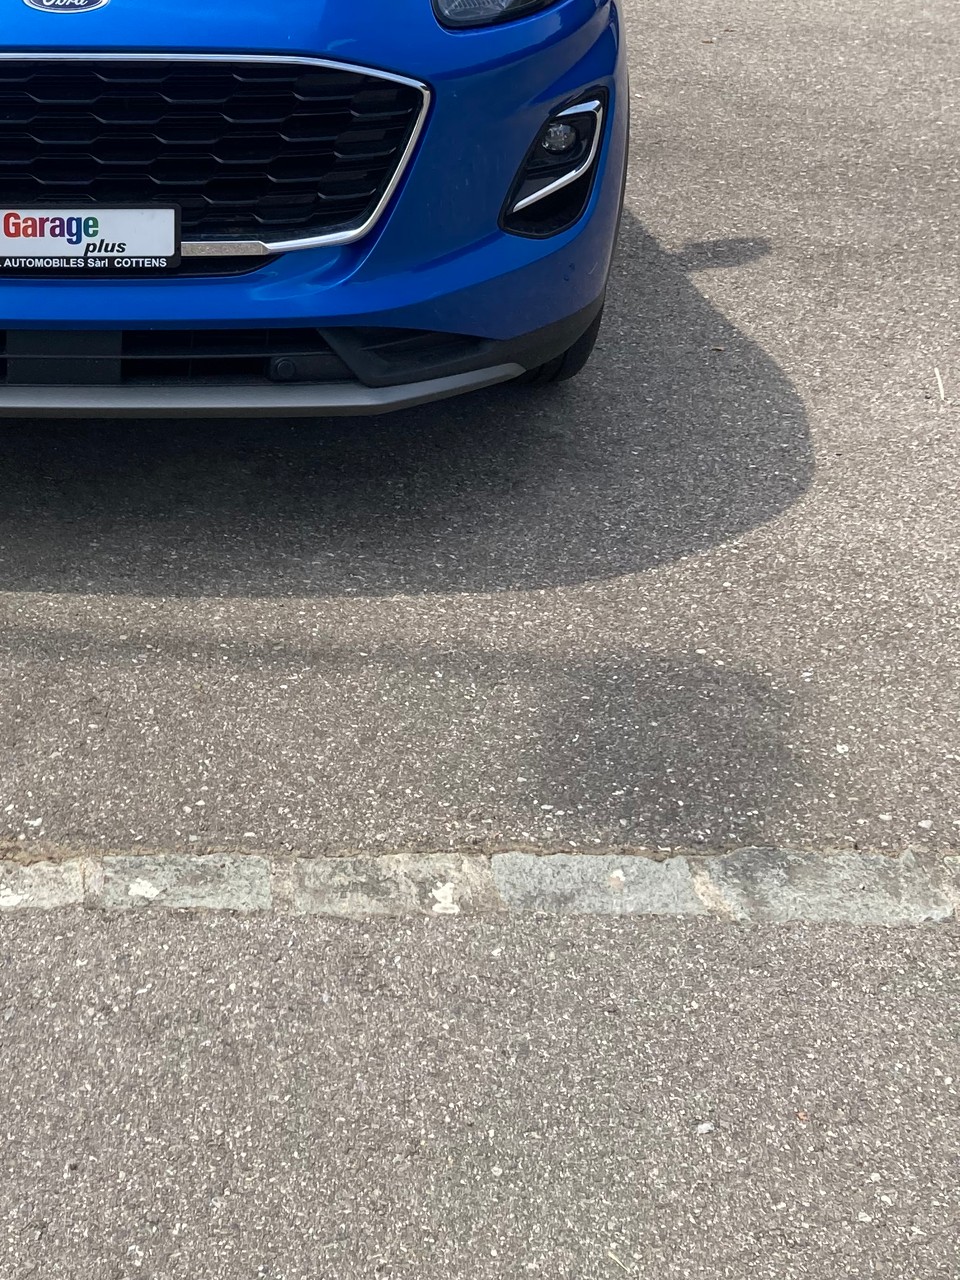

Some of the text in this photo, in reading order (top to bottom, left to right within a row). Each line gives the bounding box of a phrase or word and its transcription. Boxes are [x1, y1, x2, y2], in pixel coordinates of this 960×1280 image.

[3, 212, 99, 244] Garage
[83, 239, 127, 256] plus
[3, 257, 85, 267] AUTOMOBILES
[87, 257, 108, 267] Sàrl
[114, 257, 167, 268] COTTENS
